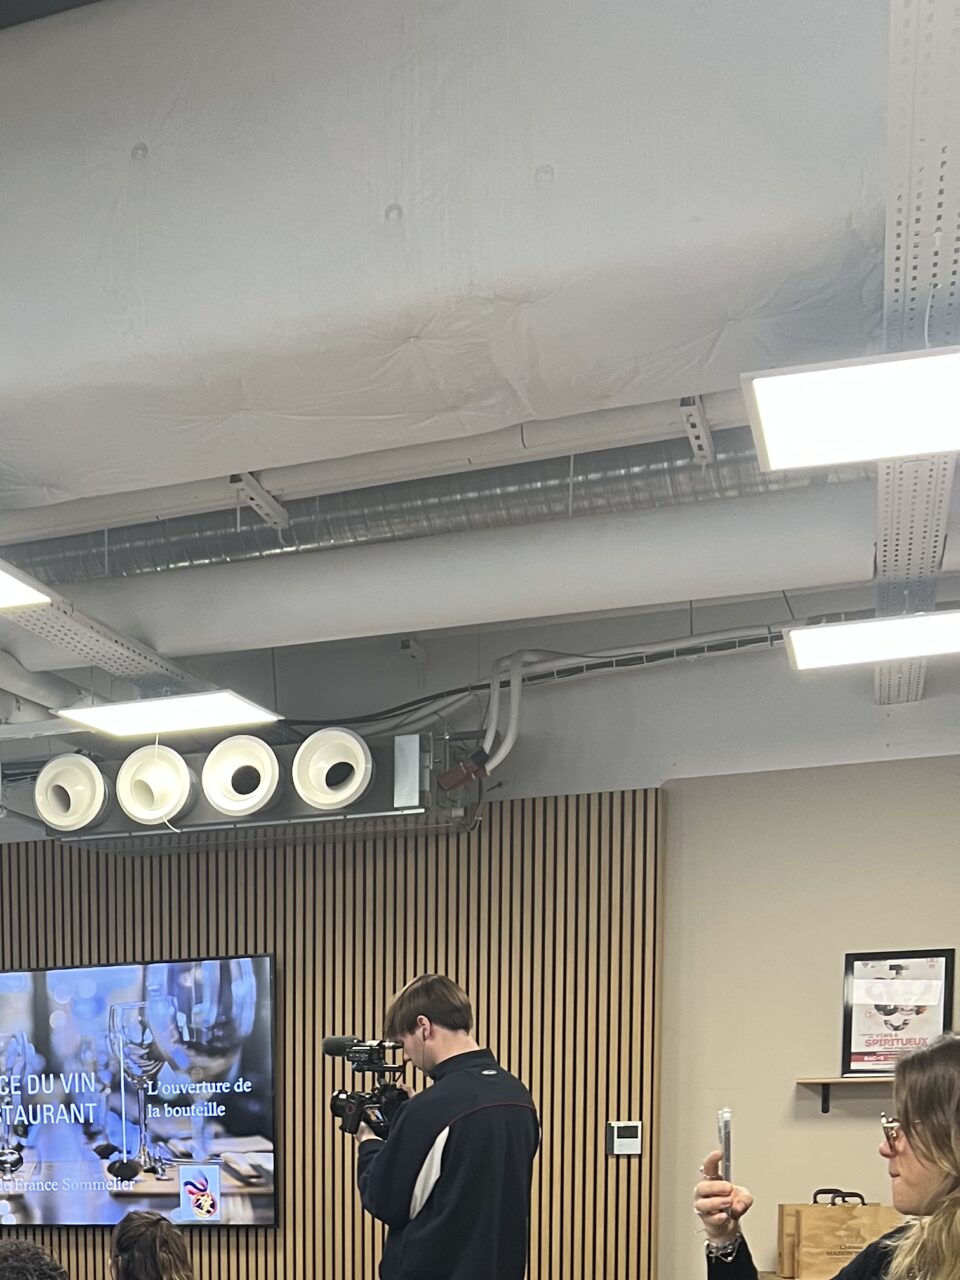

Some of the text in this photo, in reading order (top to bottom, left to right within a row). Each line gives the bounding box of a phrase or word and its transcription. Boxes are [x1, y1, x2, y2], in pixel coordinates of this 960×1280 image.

[27, 1073, 55, 1095] DU
[59, 1072, 96, 1094] VIN
[146, 1077, 252, 1096] L'ouverture de
[147, 1101, 226, 1118] la bouteille
[14, 1178, 59, 1192] France
[62, 1178, 136, 1191] Sommelier
